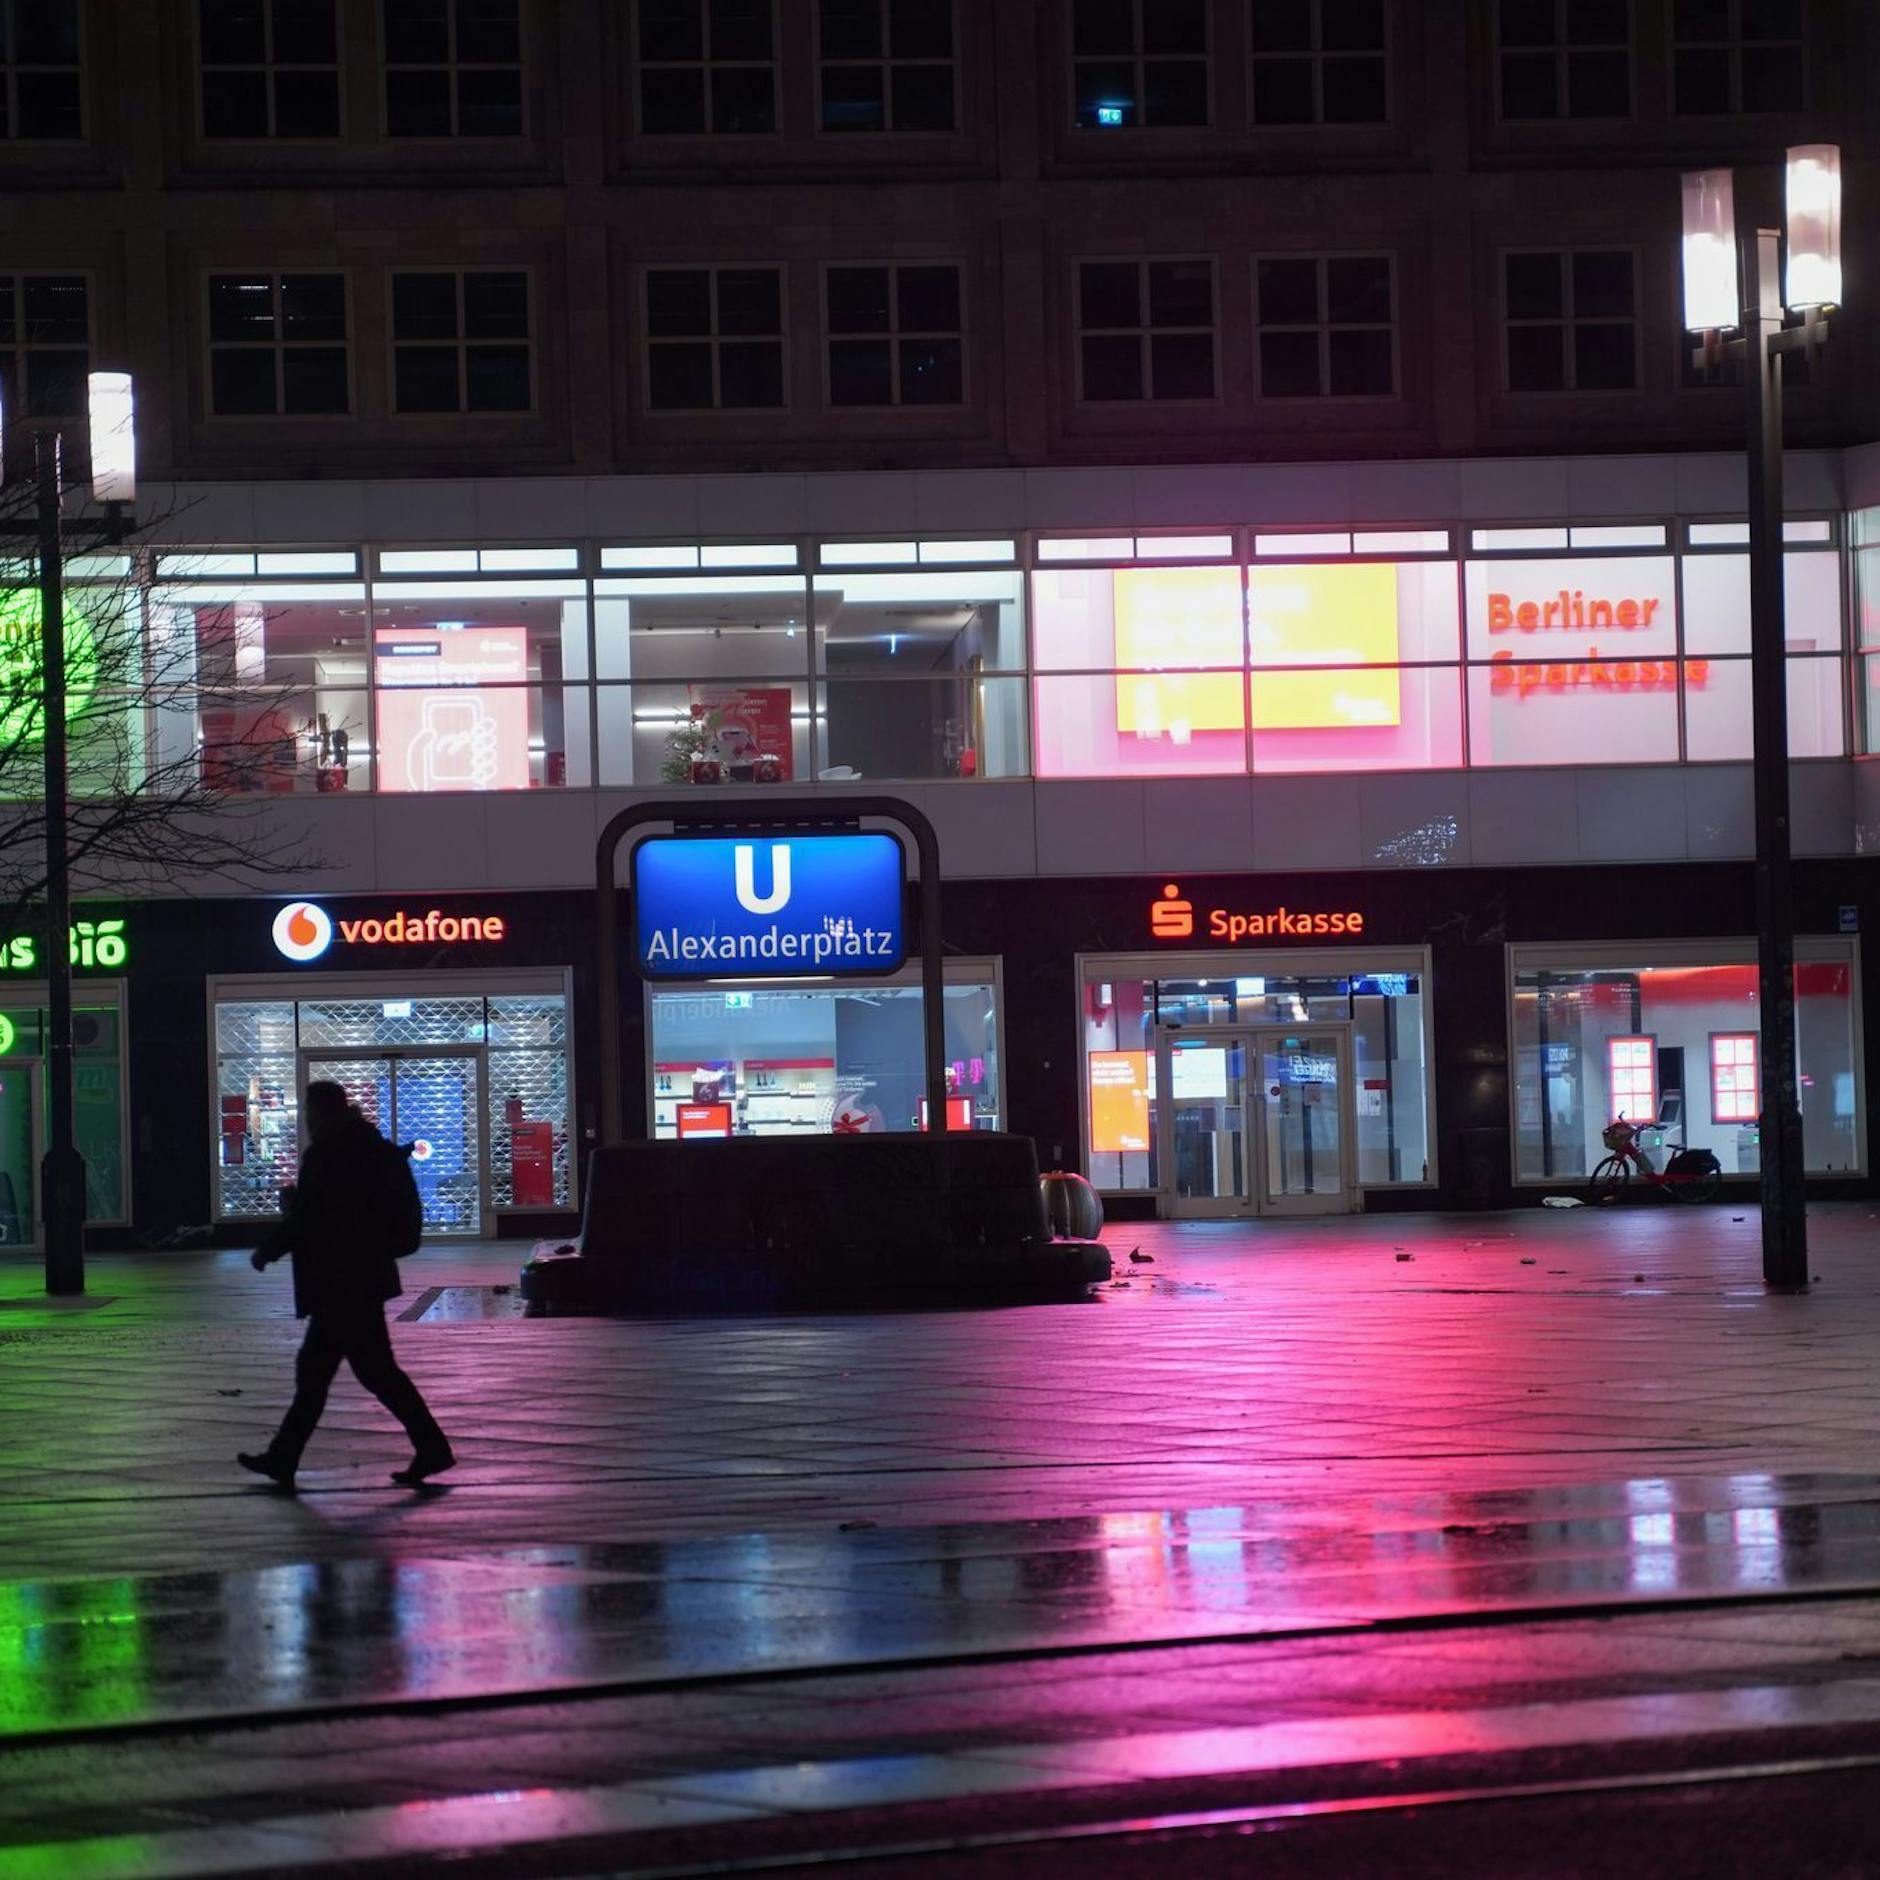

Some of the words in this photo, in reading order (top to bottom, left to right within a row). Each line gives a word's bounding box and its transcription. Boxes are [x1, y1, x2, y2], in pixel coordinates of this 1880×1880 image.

[1488, 590, 1658, 635] Berliner
[1490, 648, 1710, 700] Sparkasse
[735, 844, 791, 914] U
[339, 911, 505, 943] vodafone
[647, 926, 893, 963] Alexanderplatz
[1210, 908, 1364, 941] Sparkasse
